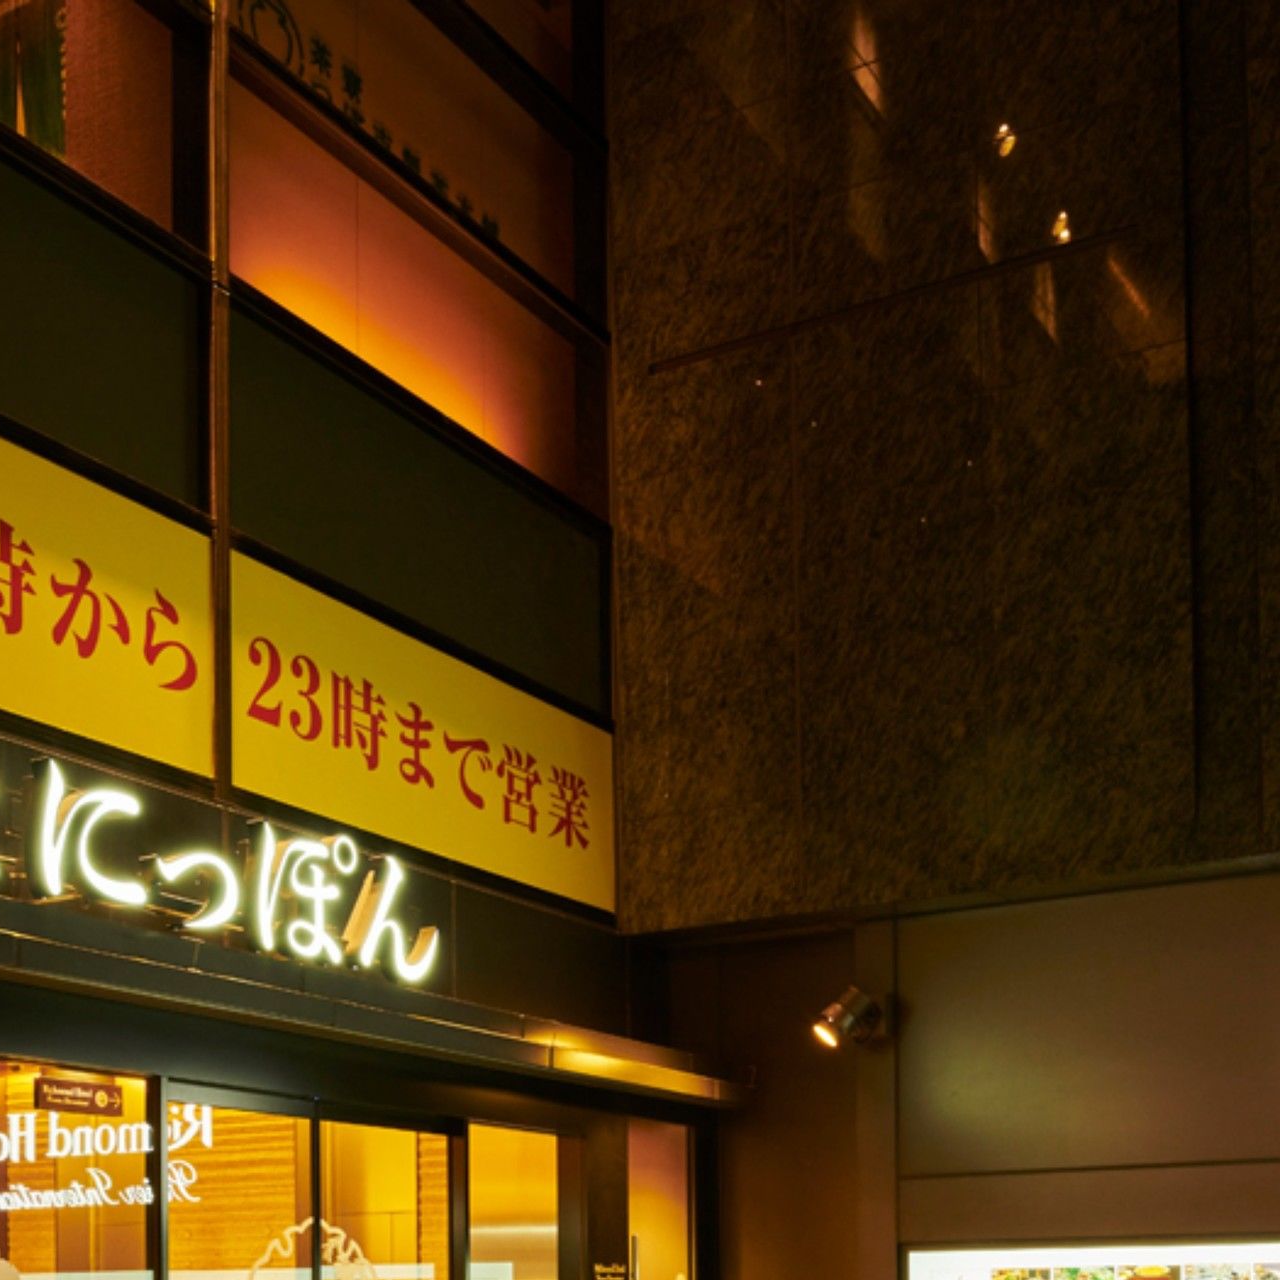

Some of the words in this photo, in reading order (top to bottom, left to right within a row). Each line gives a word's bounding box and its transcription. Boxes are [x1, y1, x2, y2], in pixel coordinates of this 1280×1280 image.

[246, 636, 591, 850] 23時まで営業
